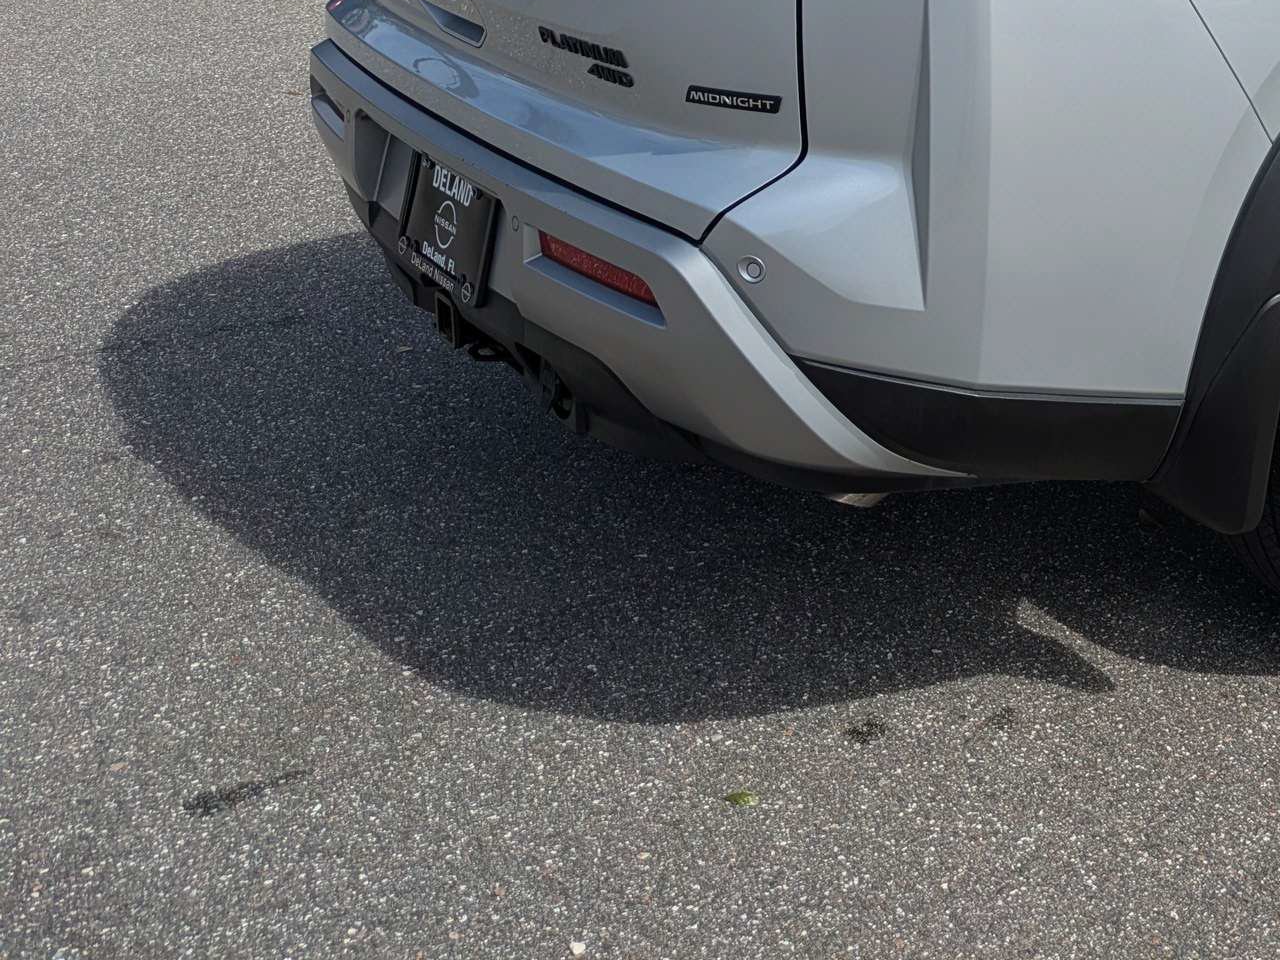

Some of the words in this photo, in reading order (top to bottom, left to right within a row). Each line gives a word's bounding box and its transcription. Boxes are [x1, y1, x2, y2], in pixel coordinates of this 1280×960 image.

[538, 25, 629, 69] PLATINUM
[586, 63, 635, 88] 4WD
[689, 90, 775, 110] MIDNIGHT
[432, 164, 474, 207] DELAND
[434, 214, 457, 235] NISSAN
[410, 251, 434, 278] DeLand
[433, 268, 454, 292] Nissan
[447, 256, 456, 275] FL
